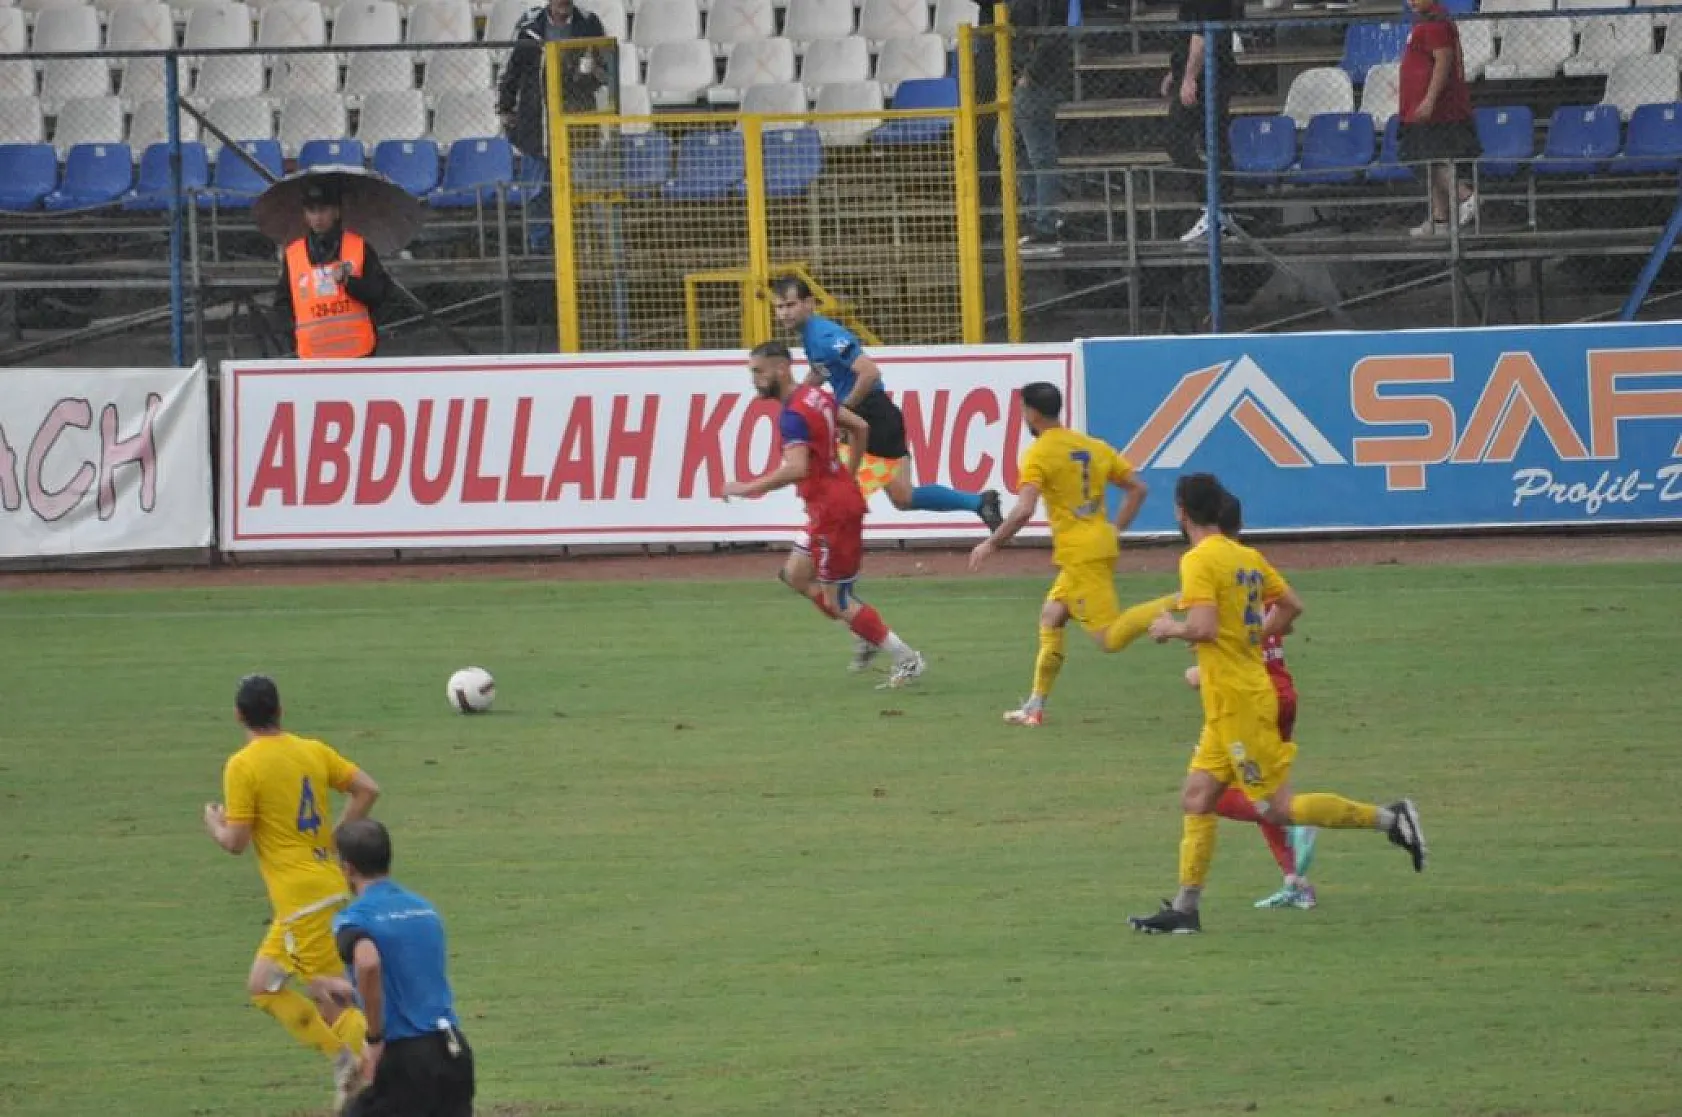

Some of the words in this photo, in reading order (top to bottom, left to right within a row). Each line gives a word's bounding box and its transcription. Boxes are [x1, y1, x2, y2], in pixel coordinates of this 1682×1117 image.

[247, 393, 661, 507] ABDULLAH
[677, 387, 1022, 499] KONC
[1351, 347, 1682, 491] ŞAF
[1068, 450, 1091, 500] 7
[297, 775, 322, 835] 4
